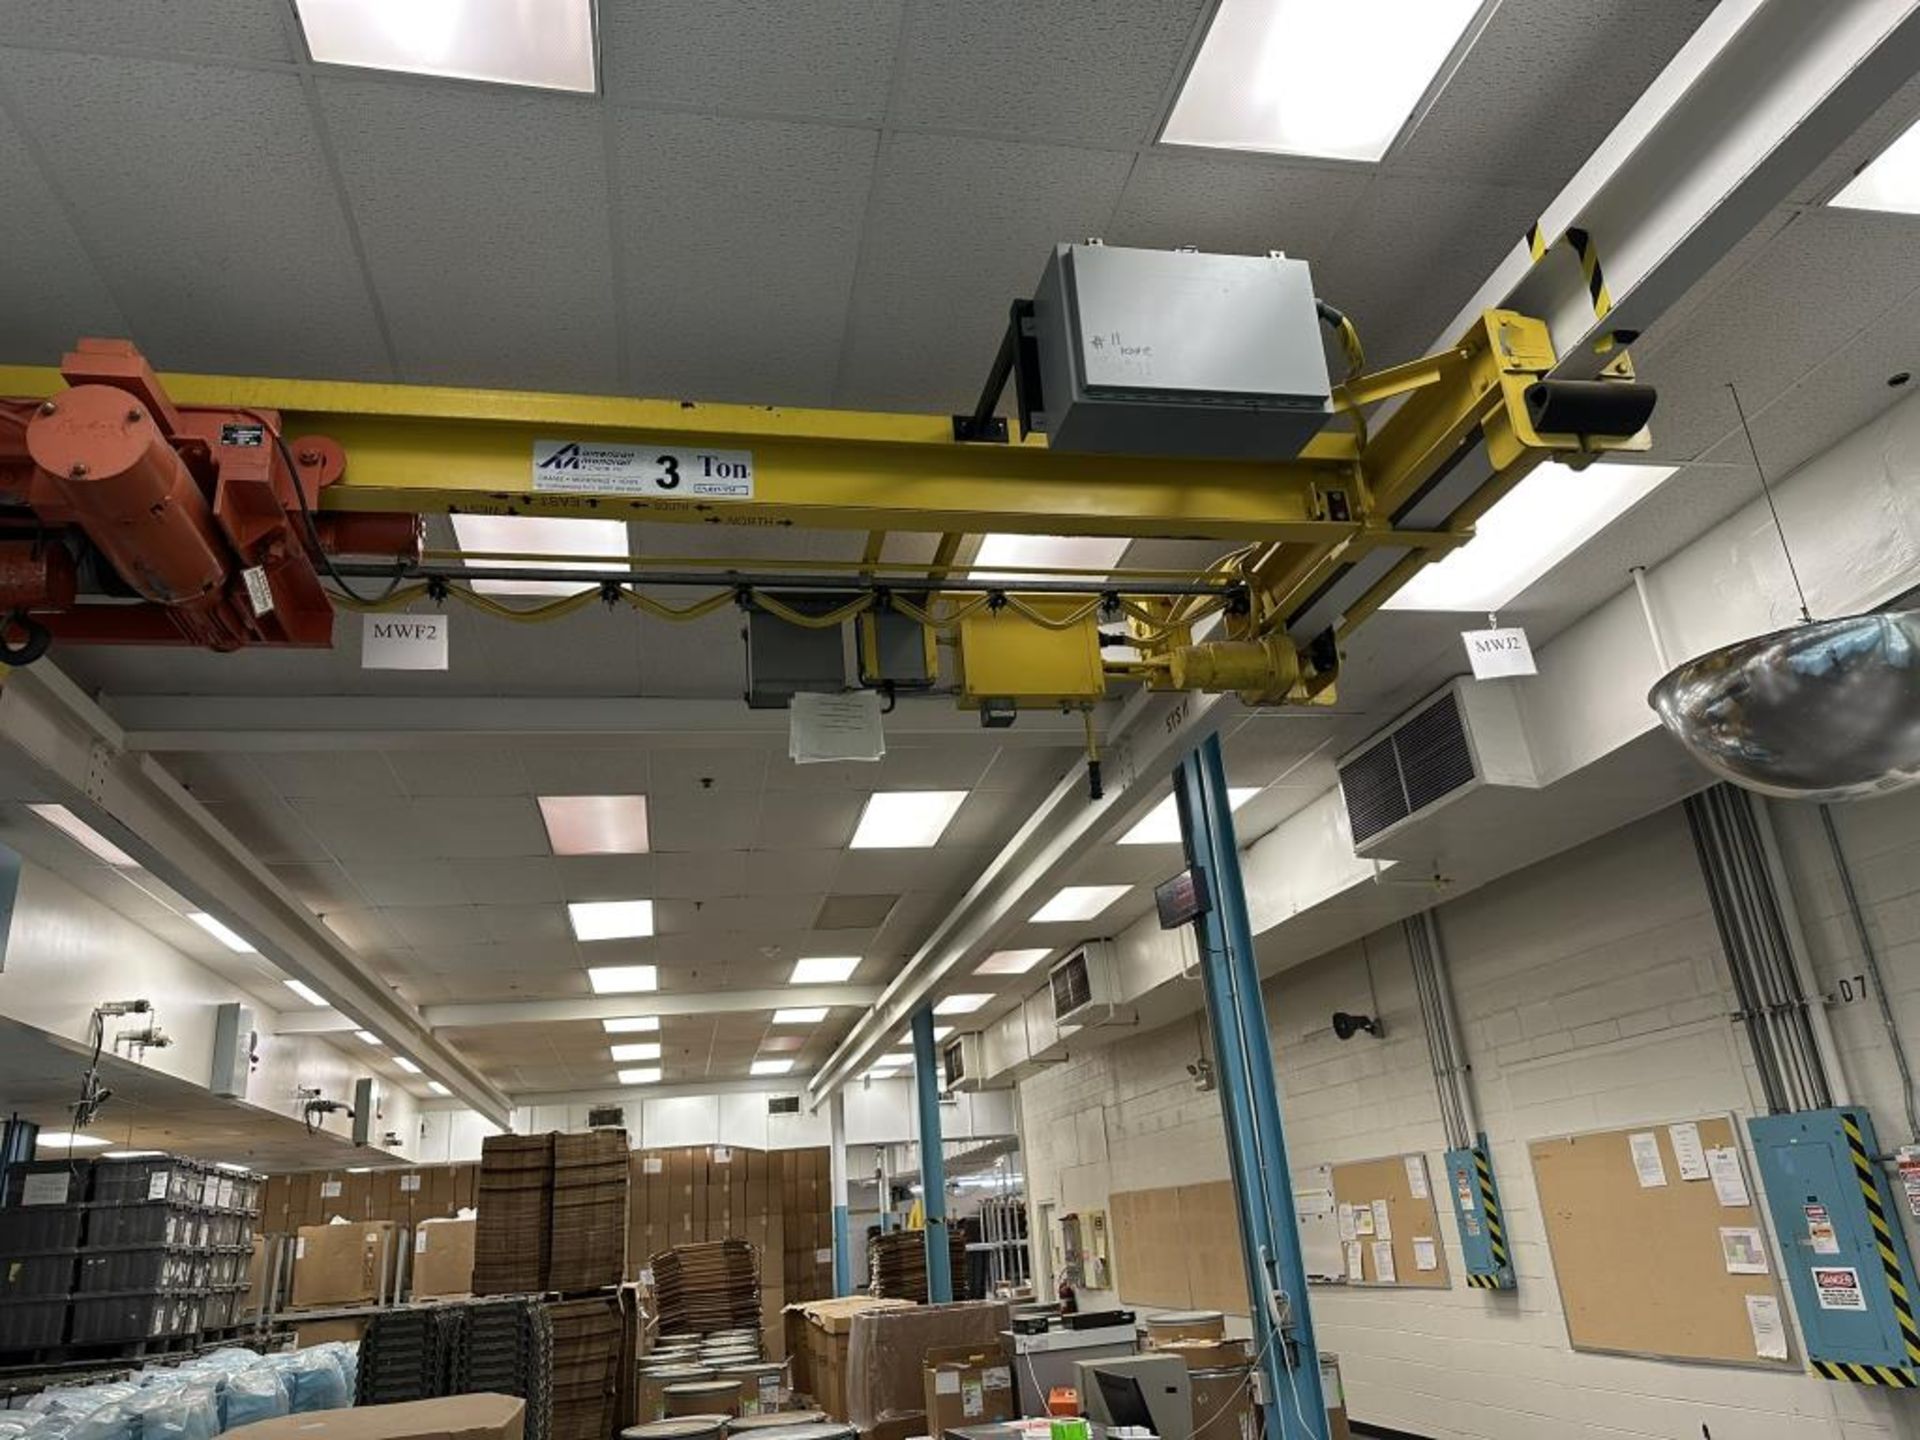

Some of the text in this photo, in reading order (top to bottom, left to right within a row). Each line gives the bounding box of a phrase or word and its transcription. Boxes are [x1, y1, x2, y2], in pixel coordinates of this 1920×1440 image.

[655, 454, 747, 490] 3 Ton
[374, 623, 437, 640] MWF2
[1475, 636, 1521, 653] MWJ2
[1838, 974, 1867, 1002] D7
